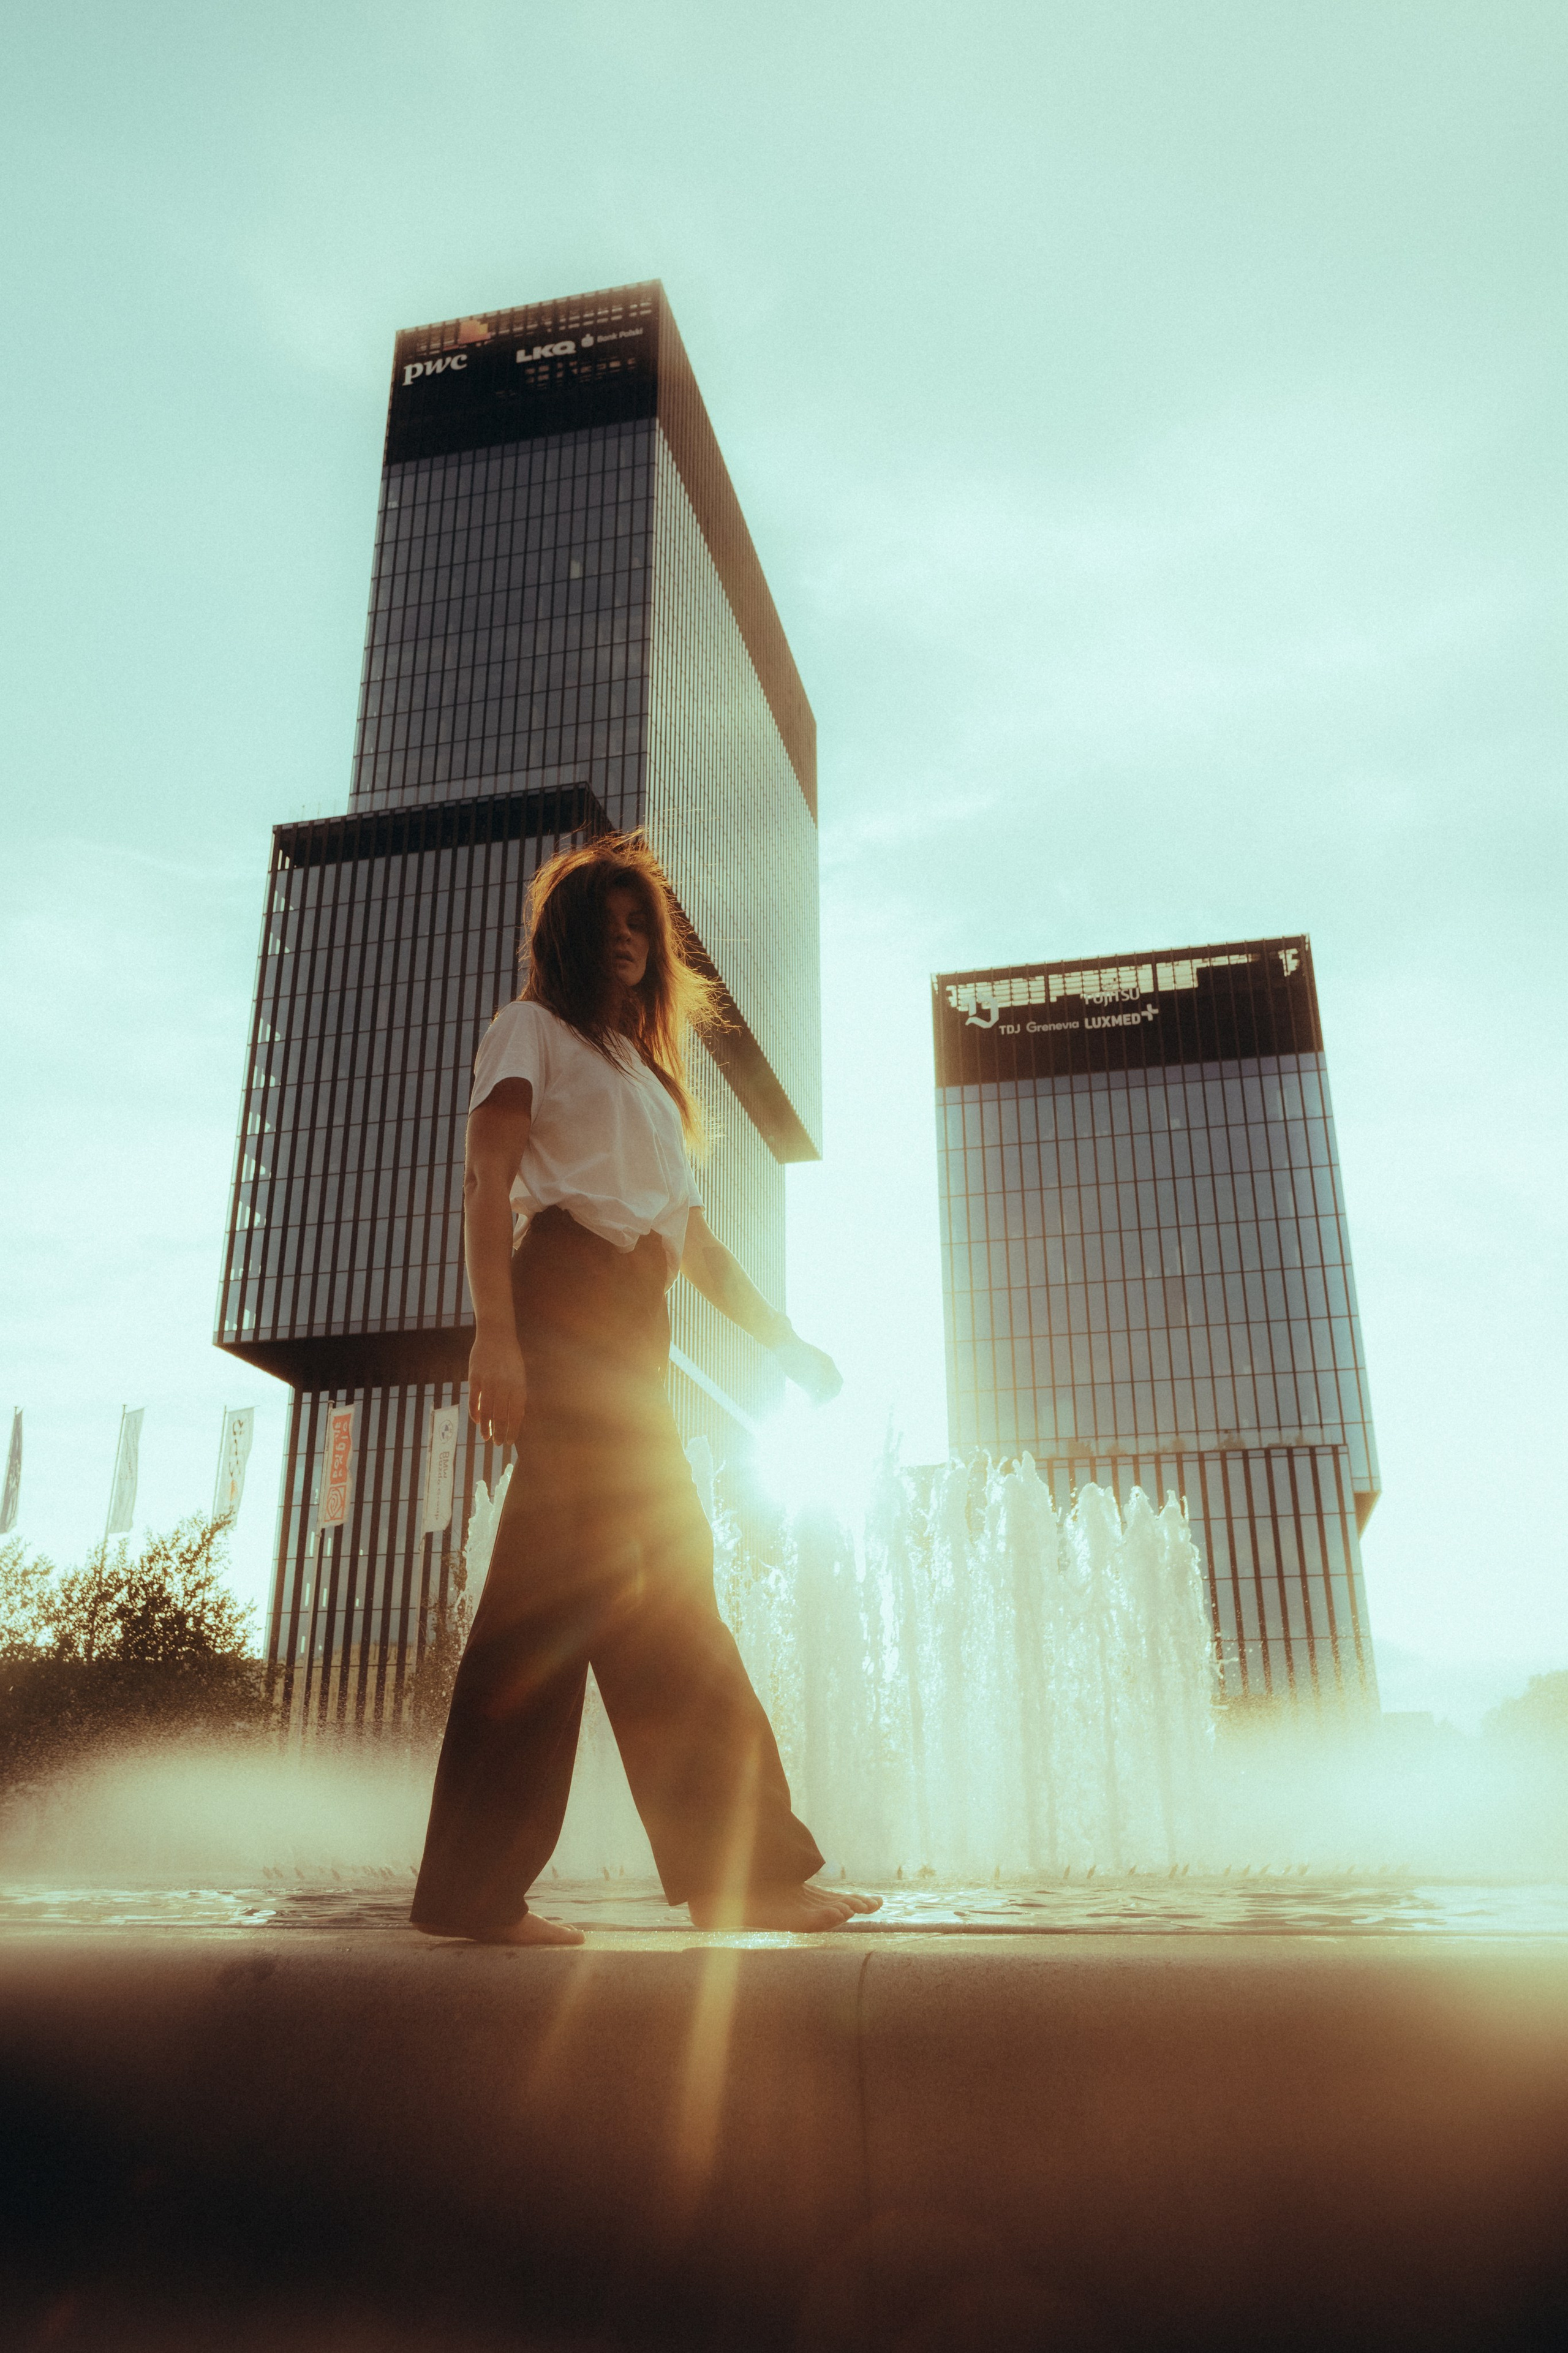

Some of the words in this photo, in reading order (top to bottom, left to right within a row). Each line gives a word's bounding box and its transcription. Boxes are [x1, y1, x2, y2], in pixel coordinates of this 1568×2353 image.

[516, 341, 576, 363] LKQ
[402, 354, 467, 386] pwc
[999, 1024, 1020, 1035] TDJ
[1026, 1021, 1079, 1033] Grenevia
[1084, 1013, 1141, 1029] LUXMED
